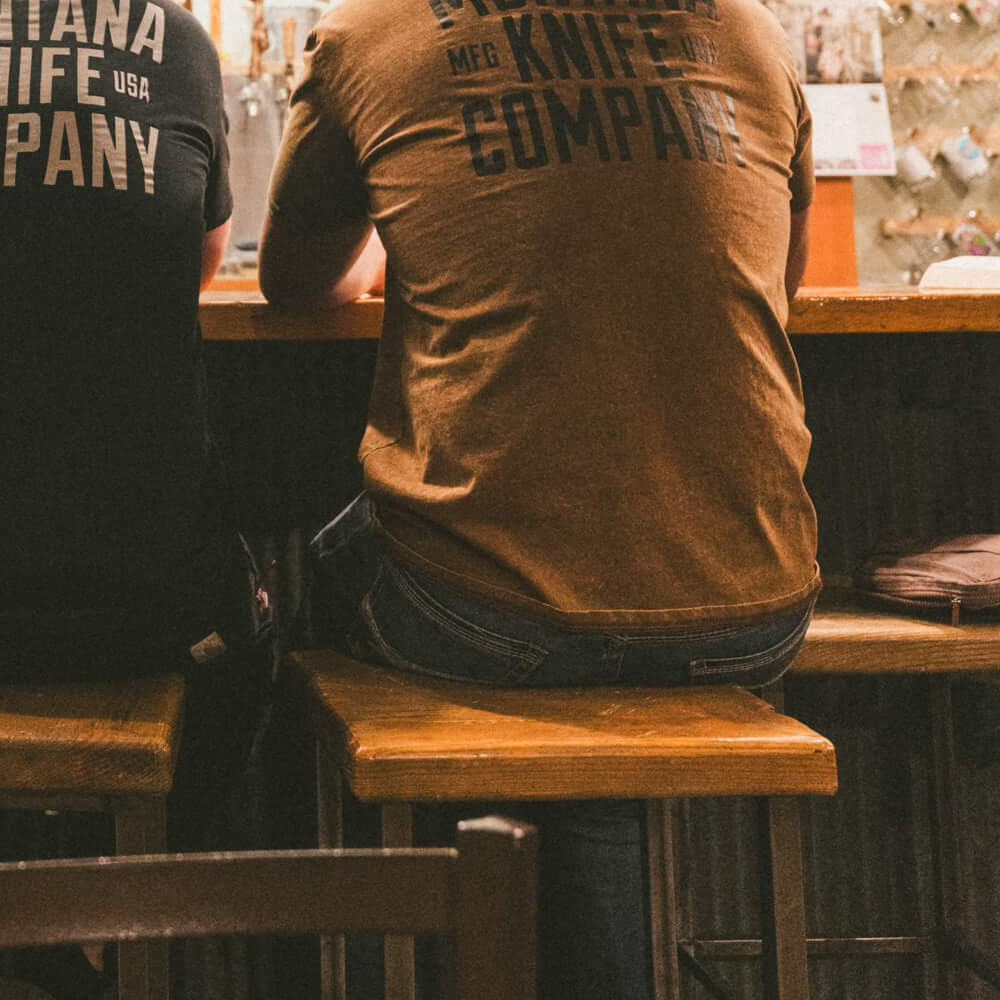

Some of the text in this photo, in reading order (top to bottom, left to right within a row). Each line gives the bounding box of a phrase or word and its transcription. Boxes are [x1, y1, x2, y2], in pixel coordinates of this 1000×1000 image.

[448, 41, 500, 77] MFG
[502, 12, 684, 84] KNIFE
[113, 70, 150, 103] USA
[461, 85, 748, 178] COMPANY
